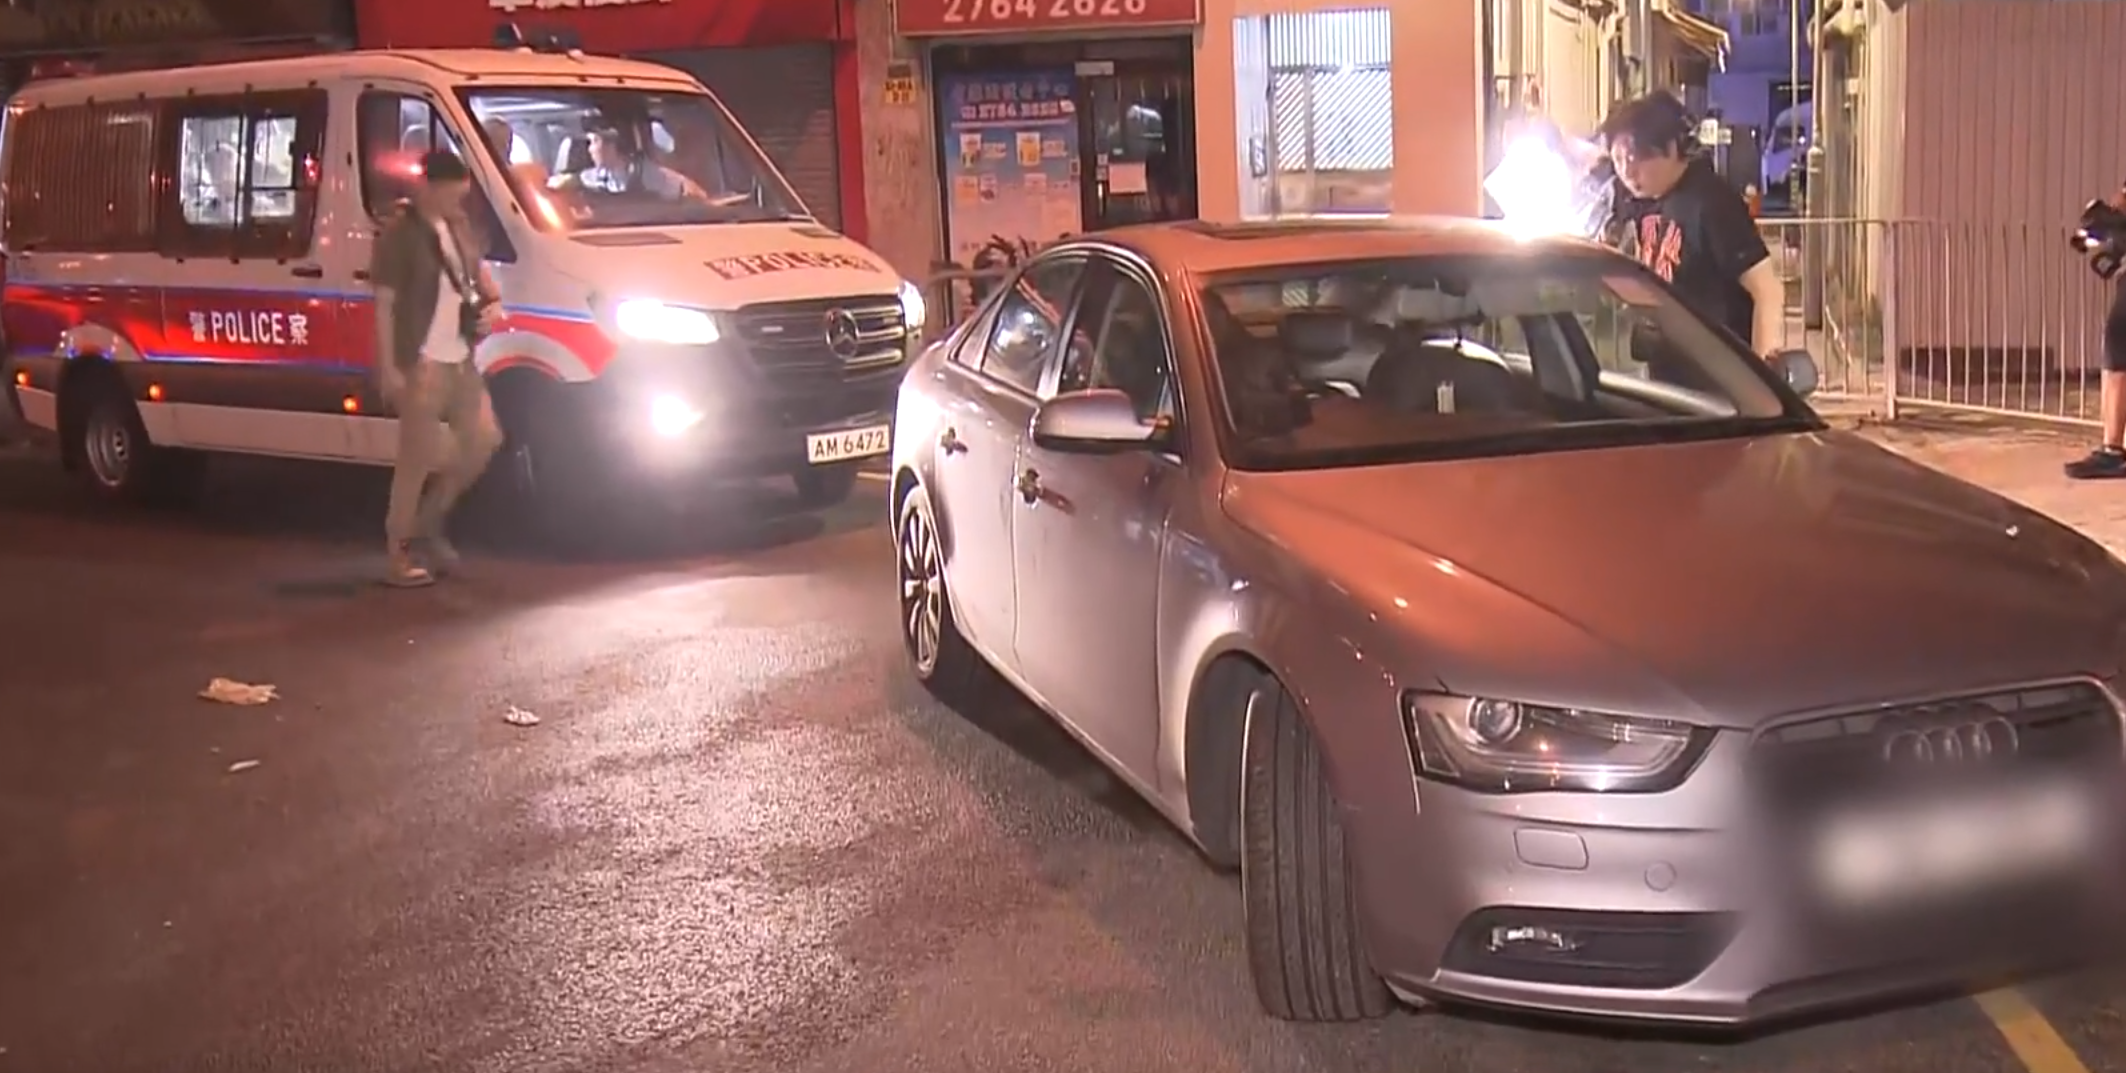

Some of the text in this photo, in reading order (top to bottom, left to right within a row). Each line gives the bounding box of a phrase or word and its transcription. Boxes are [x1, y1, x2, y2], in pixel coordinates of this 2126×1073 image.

[211, 310, 285, 344] POLICE
[288, 312, 308, 345] 察
[815, 430, 885, 458] AM 6472
